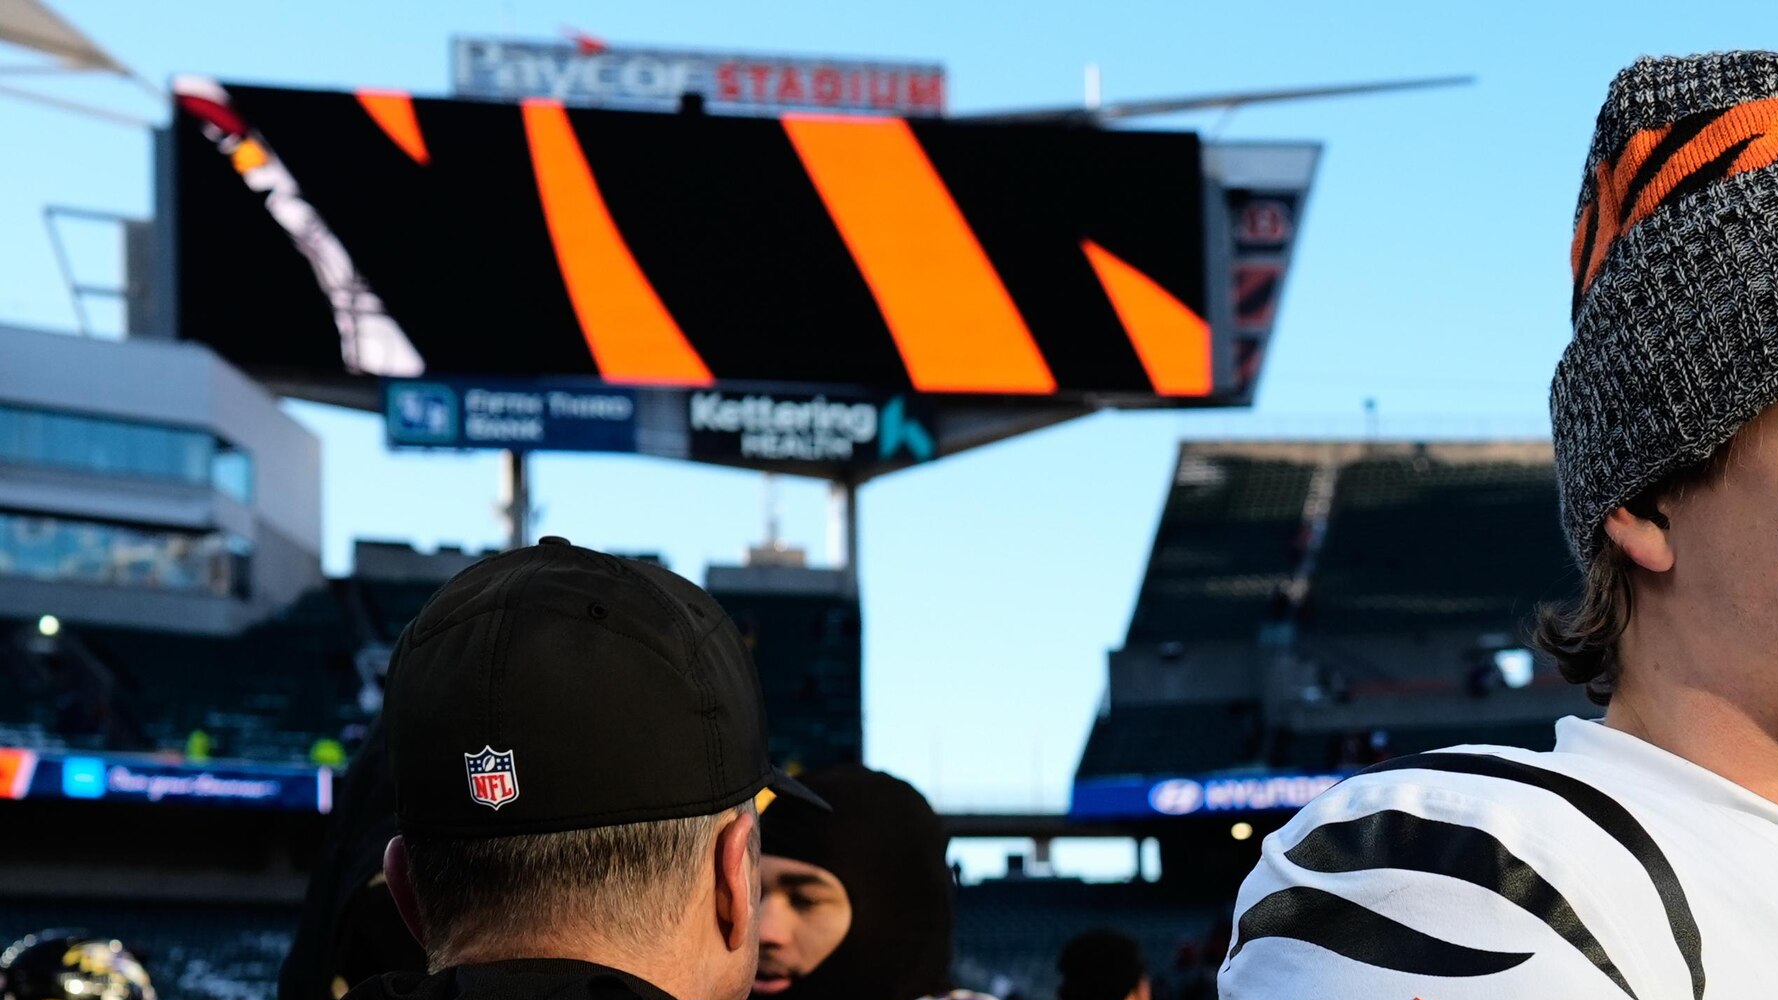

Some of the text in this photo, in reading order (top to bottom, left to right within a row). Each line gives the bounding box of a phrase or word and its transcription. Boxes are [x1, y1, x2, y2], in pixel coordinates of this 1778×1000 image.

[457, 40, 943, 107] Paycor STADIUM
[690, 391, 878, 443] Kettering
[742, 433, 853, 460] HEALTH
[473, 774, 513, 801] NFL
[1204, 776, 1342, 810] HYUND
